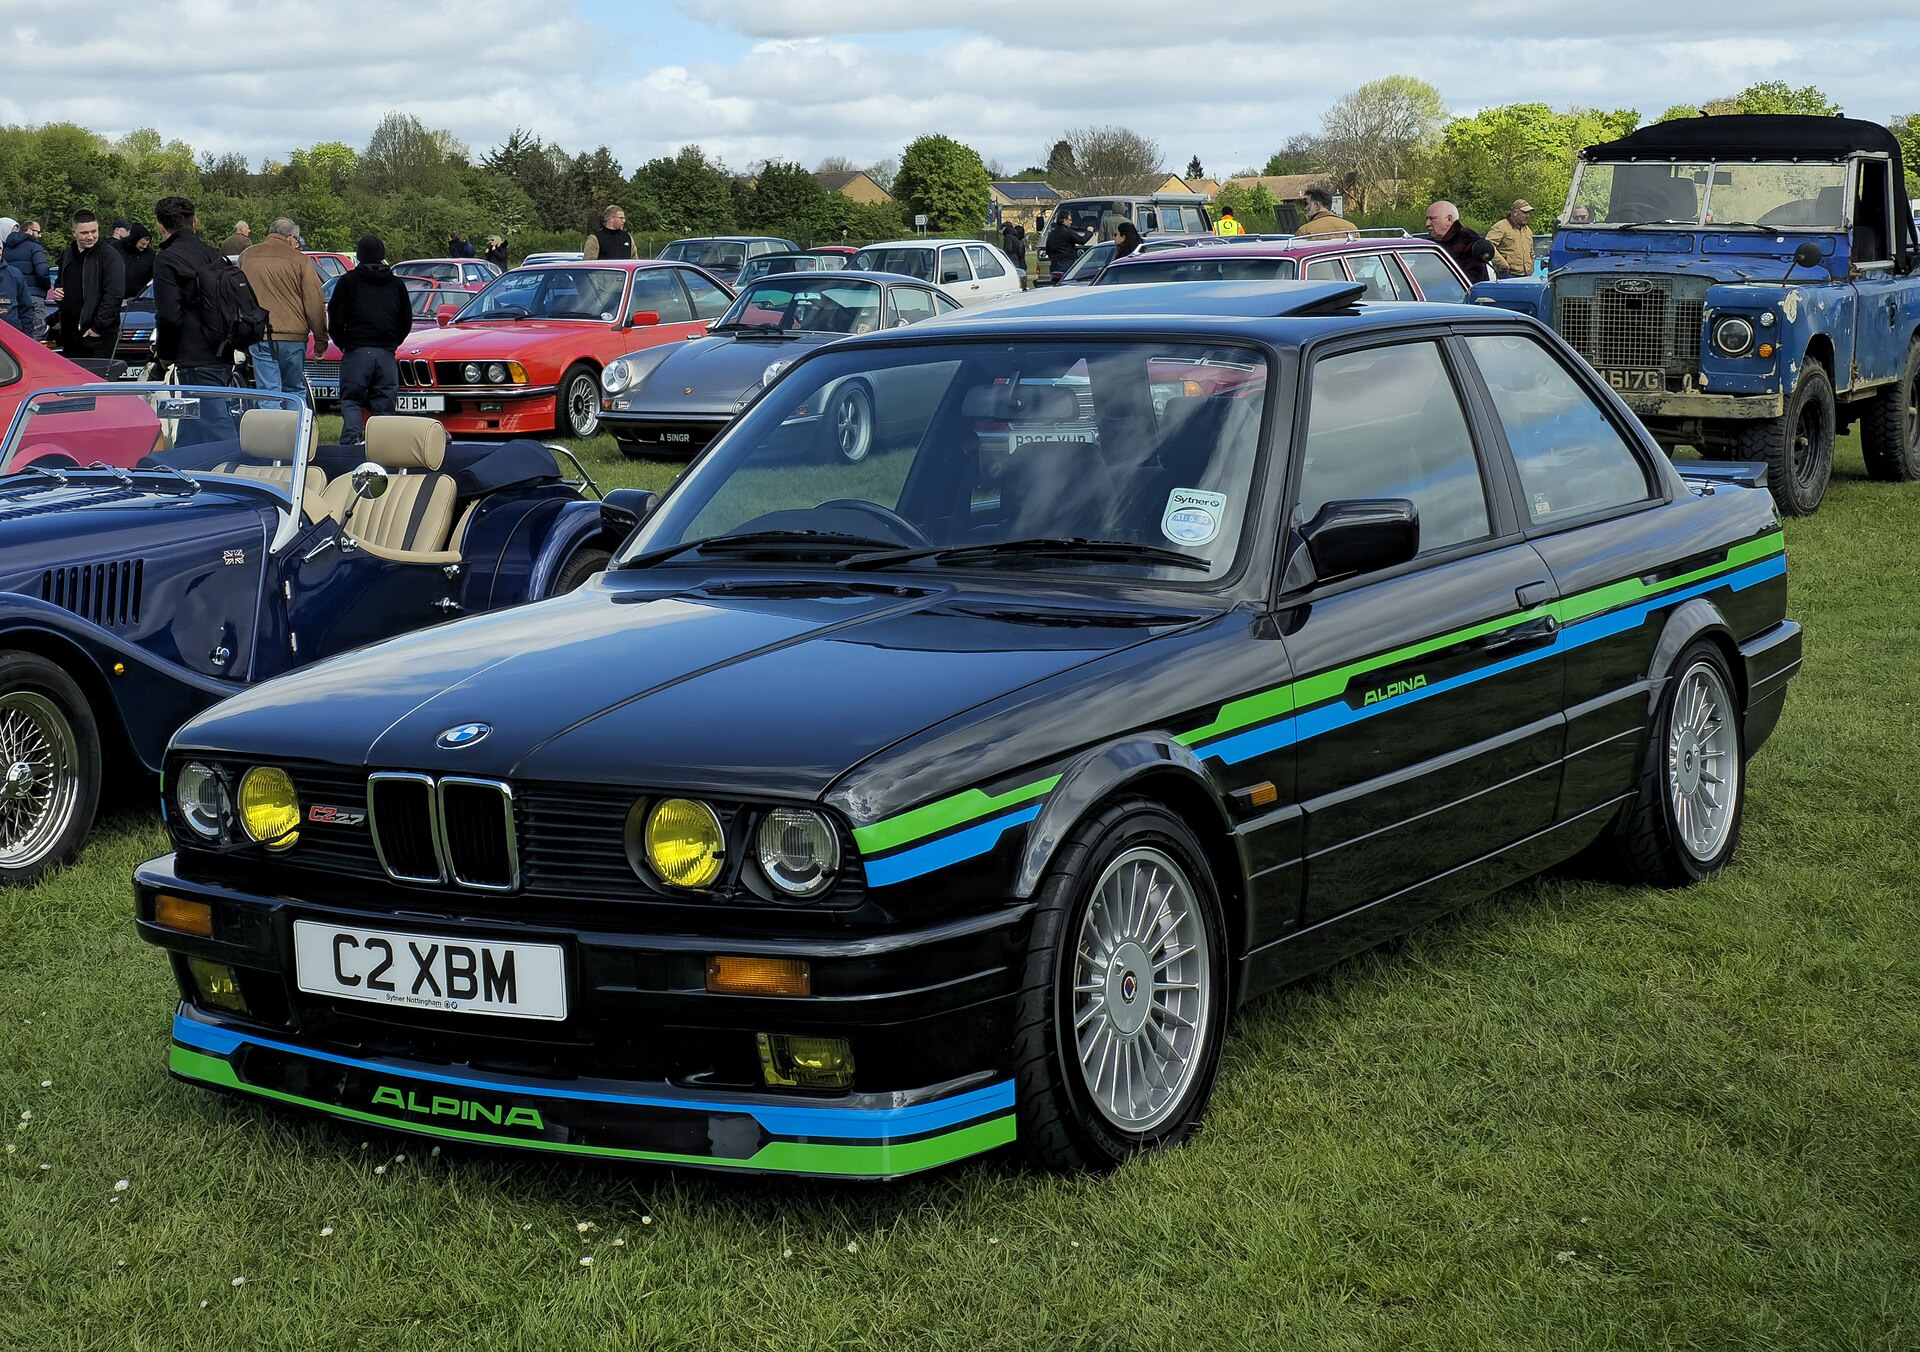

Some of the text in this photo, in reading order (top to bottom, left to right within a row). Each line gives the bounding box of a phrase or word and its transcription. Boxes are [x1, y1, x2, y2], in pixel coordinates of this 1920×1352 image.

[412, 397, 427, 410] BM
[659, 433, 665, 442] A
[1173, 494, 1210, 506] Sytner
[1363, 674, 1427, 706] ALPINA
[332, 933, 517, 1004] C2 XBM
[385, 993, 442, 1007] Sytner Nottingham
[371, 1085, 545, 1130] ALPINA
